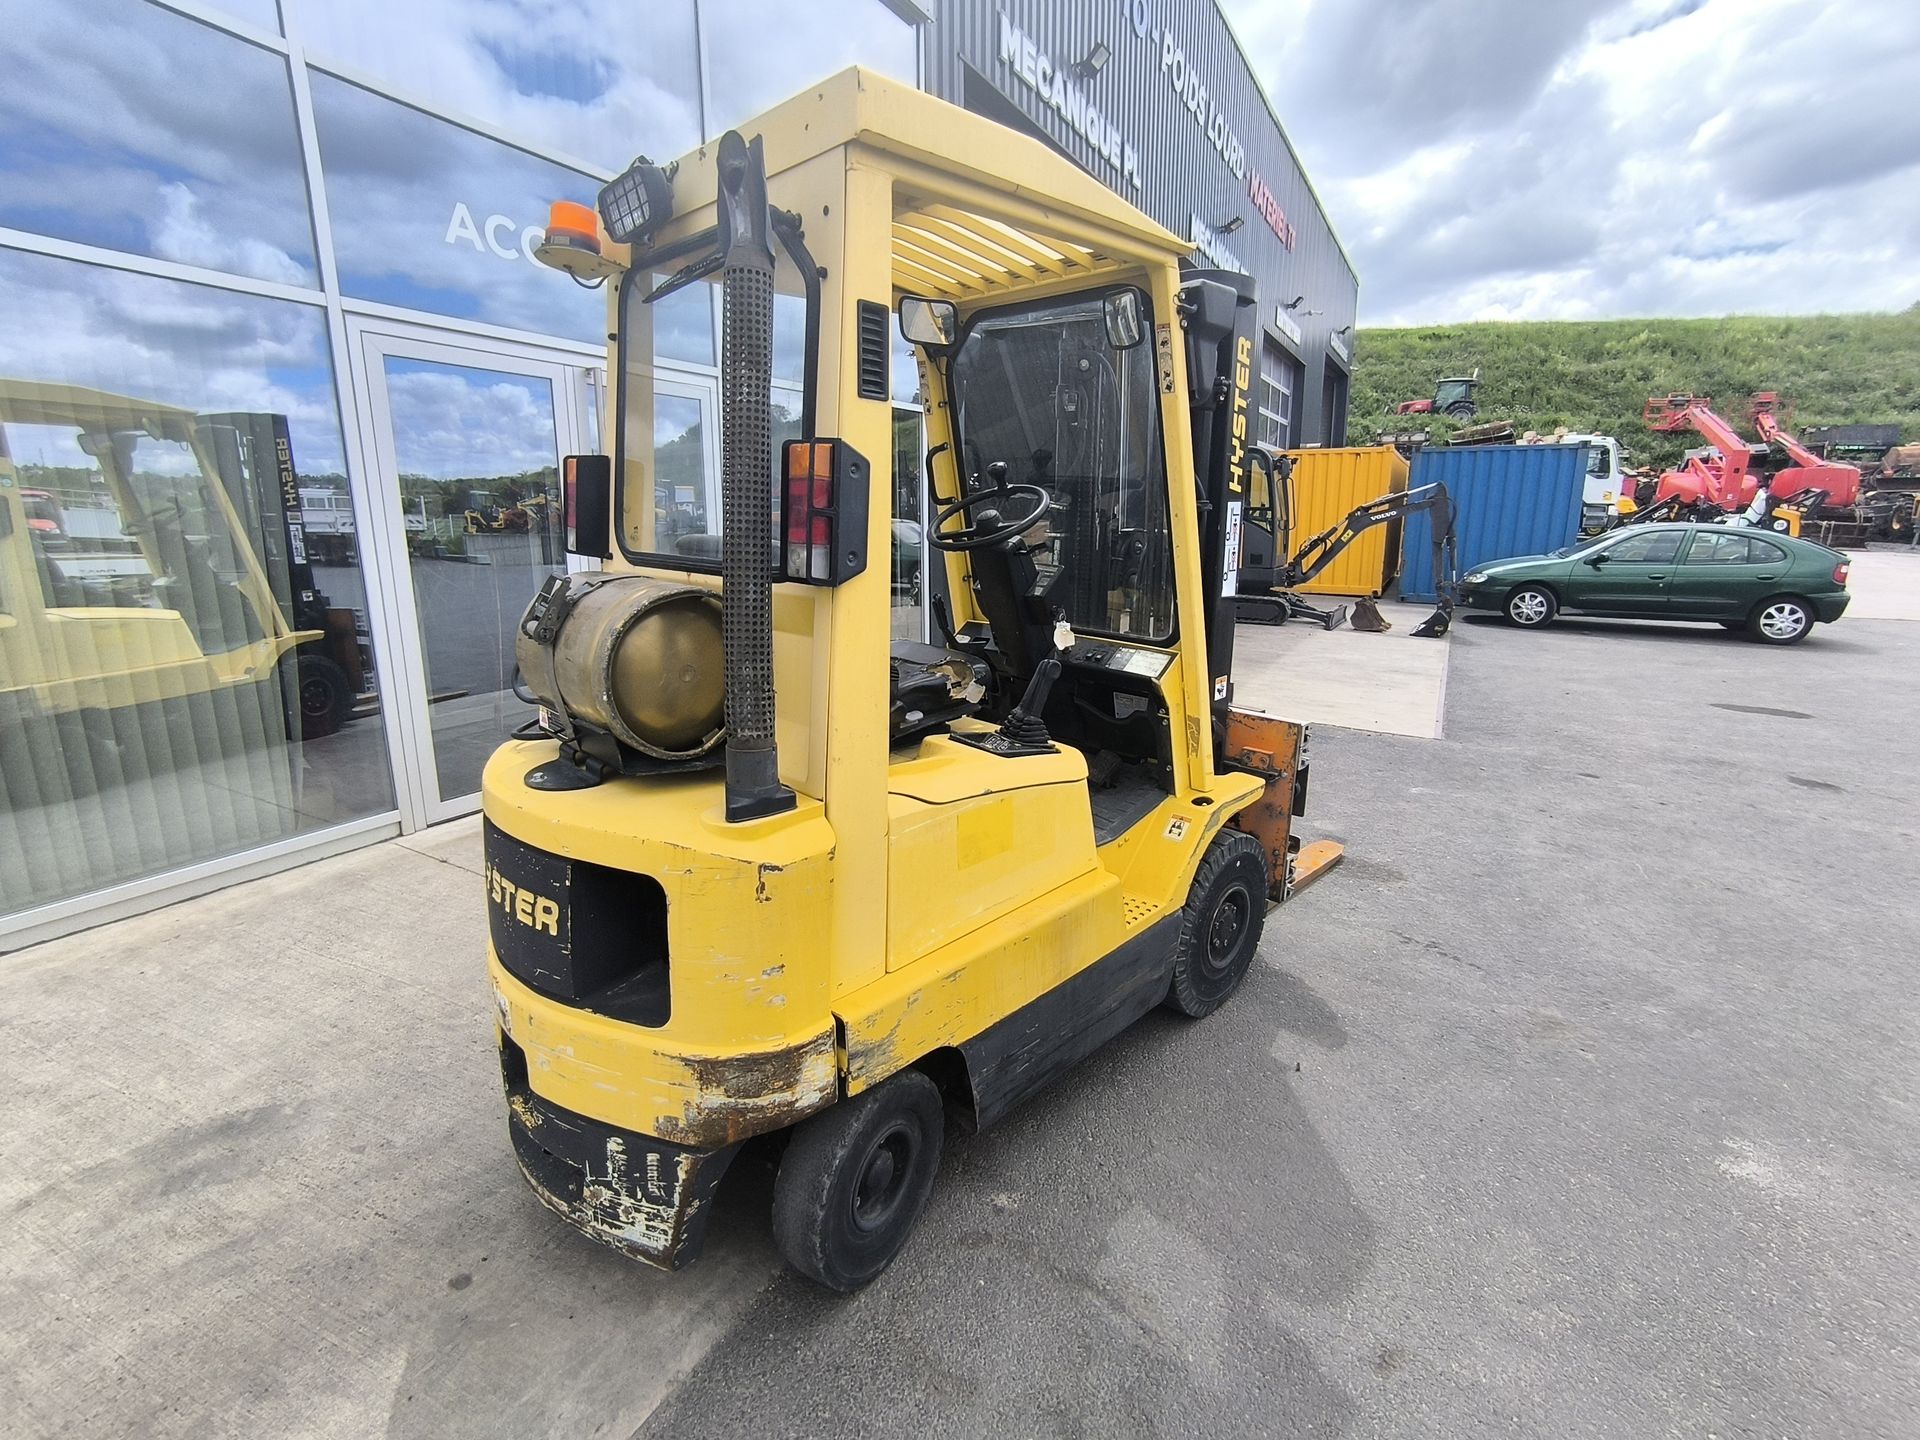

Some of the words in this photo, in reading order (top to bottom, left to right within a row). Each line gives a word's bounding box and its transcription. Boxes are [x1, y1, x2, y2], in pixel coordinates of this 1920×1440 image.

[1000, 12, 1122, 172] MECANIQUE
[1123, 140, 1141, 191] PL
[1162, 28, 1206, 126] POIDS
[1207, 101, 1245, 180] LOURD
[1229, 336, 1251, 493] HYSTER
[1371, 511, 1397, 520] VOLVO
